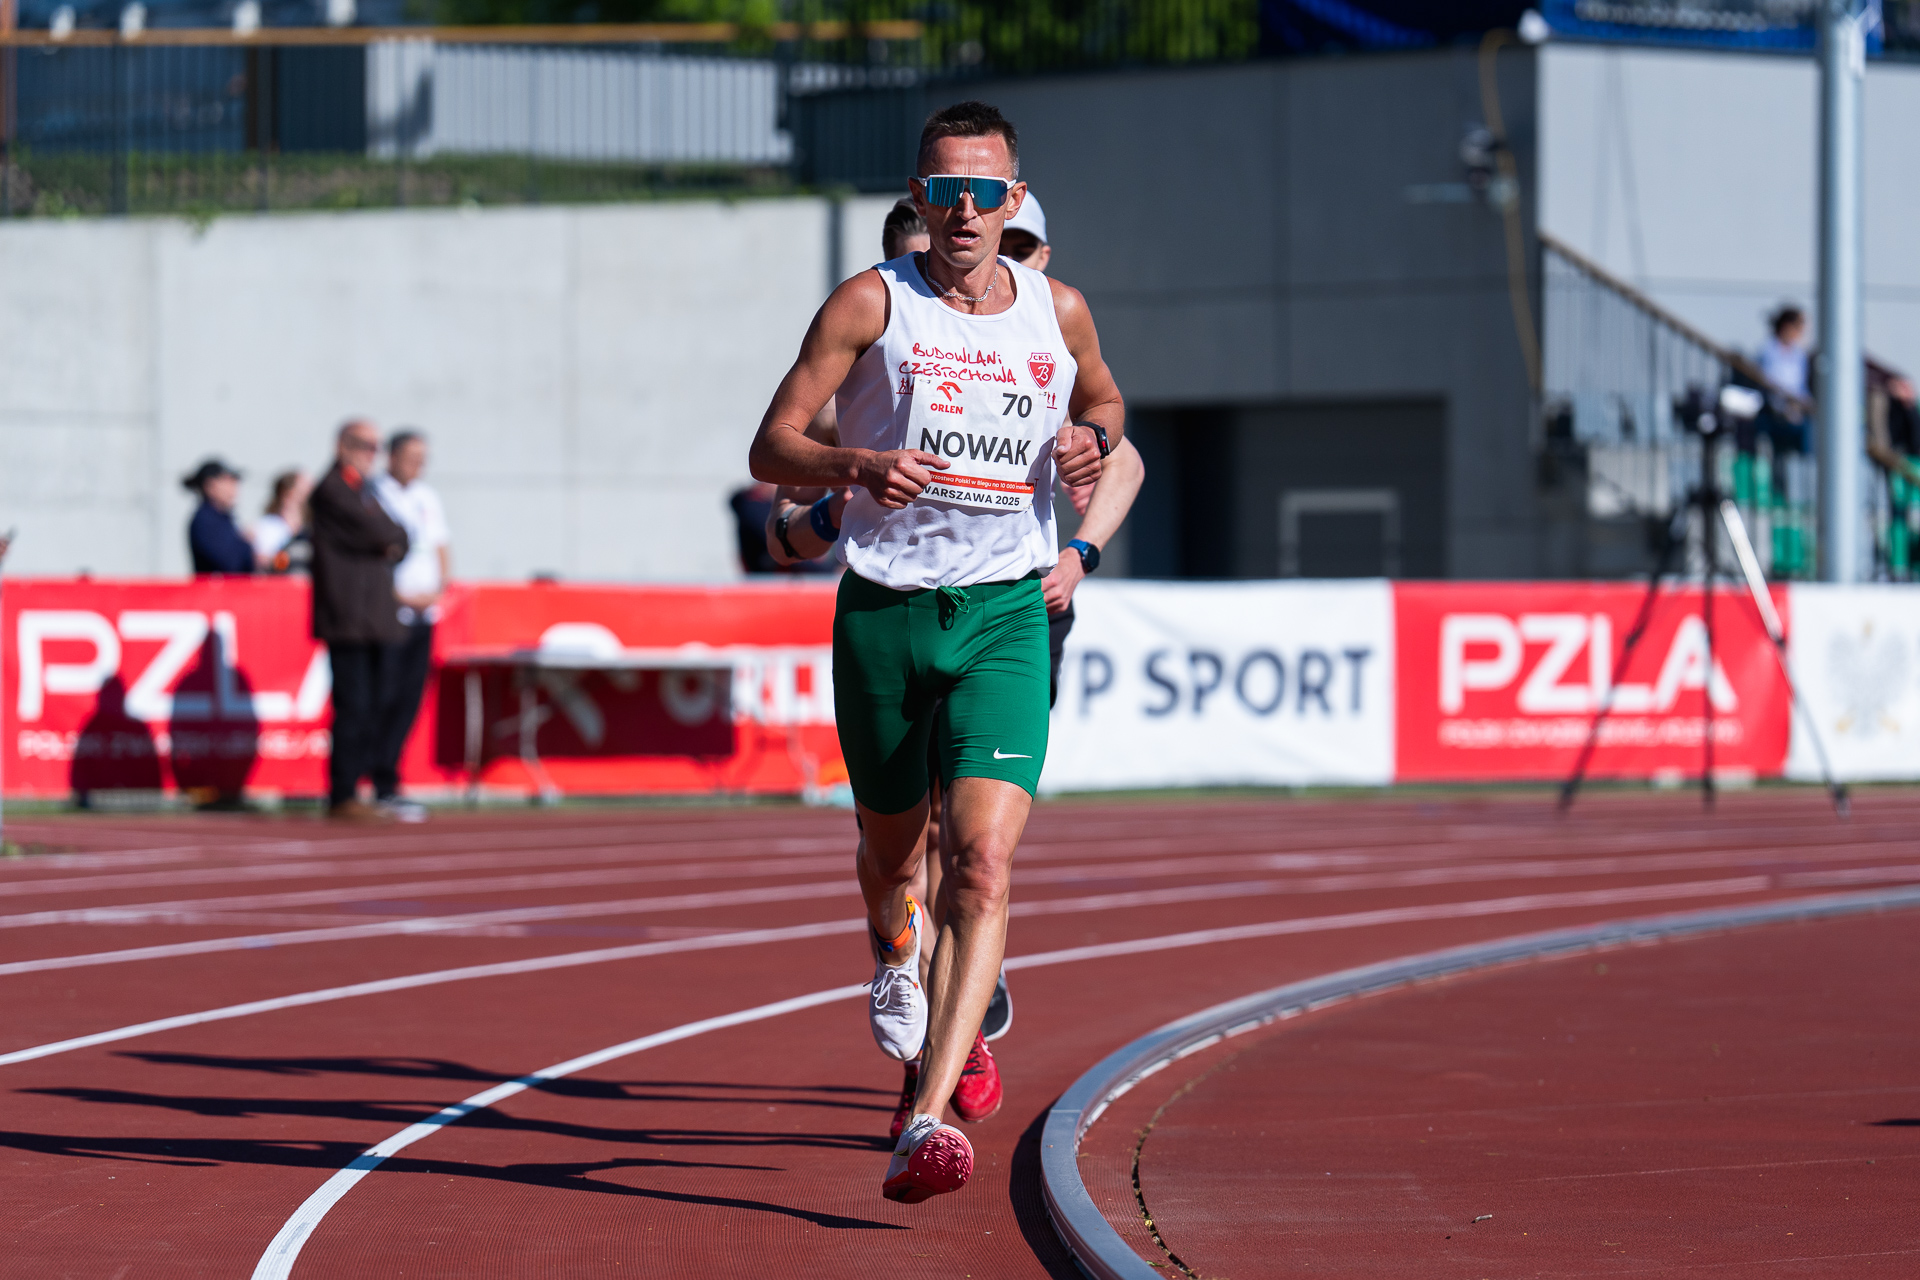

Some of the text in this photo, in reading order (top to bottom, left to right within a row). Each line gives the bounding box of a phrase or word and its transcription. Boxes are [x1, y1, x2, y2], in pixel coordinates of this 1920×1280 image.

[930, 402, 964, 415] ORLEN
[1002, 392, 1033, 419] 70
[919, 427, 1032, 466] NOWAK
[955, 477, 971, 485] Polski
[977, 480, 992, 488] Biegu
[995, 495, 1020, 507] 2025
[1440, 612, 1740, 715] PZLA
[1143, 648, 1373, 717] SPORT
